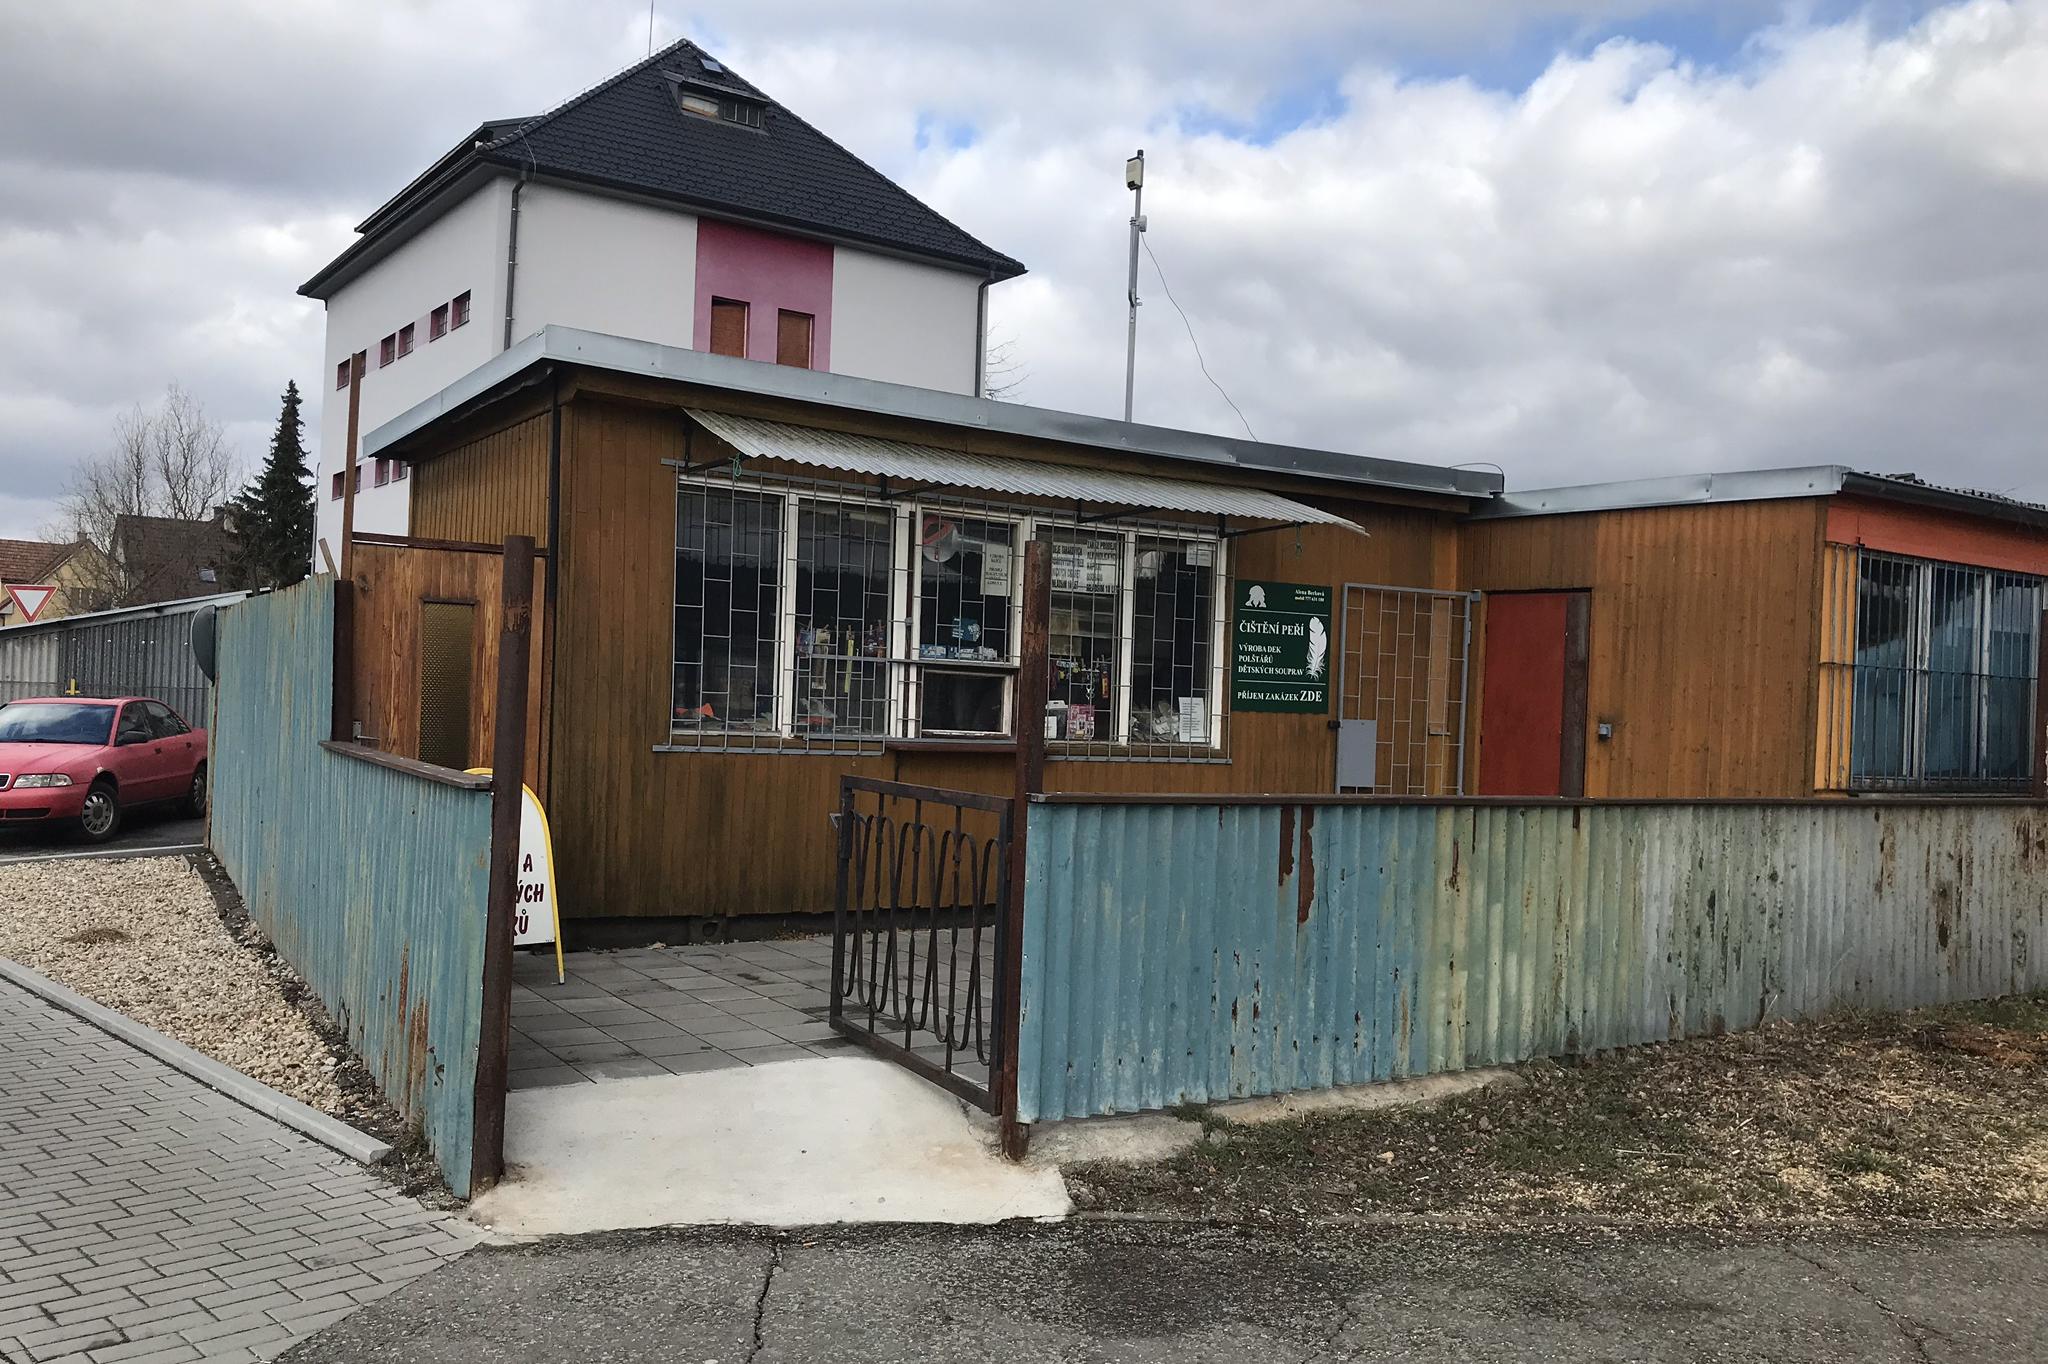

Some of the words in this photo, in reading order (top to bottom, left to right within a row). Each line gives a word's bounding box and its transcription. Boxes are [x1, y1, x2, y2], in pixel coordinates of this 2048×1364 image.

[1239, 620, 1279, 634] ČIŠTĚNÍ
[1281, 622, 1304, 636] PEŘÍ
[1239, 643, 1267, 653] VÝROBA
[1238, 665, 1274, 675] DĚTSKÝCH
[1274, 667, 1304, 676] SOUPRAV
[1237, 691, 1264, 700] PŘÍJEM
[1265, 691, 1299, 701] ZAKÁZEK
[1300, 690, 1322, 702] ZDE
[523, 853, 533, 872] A
[516, 879, 544, 903] ÝCH
